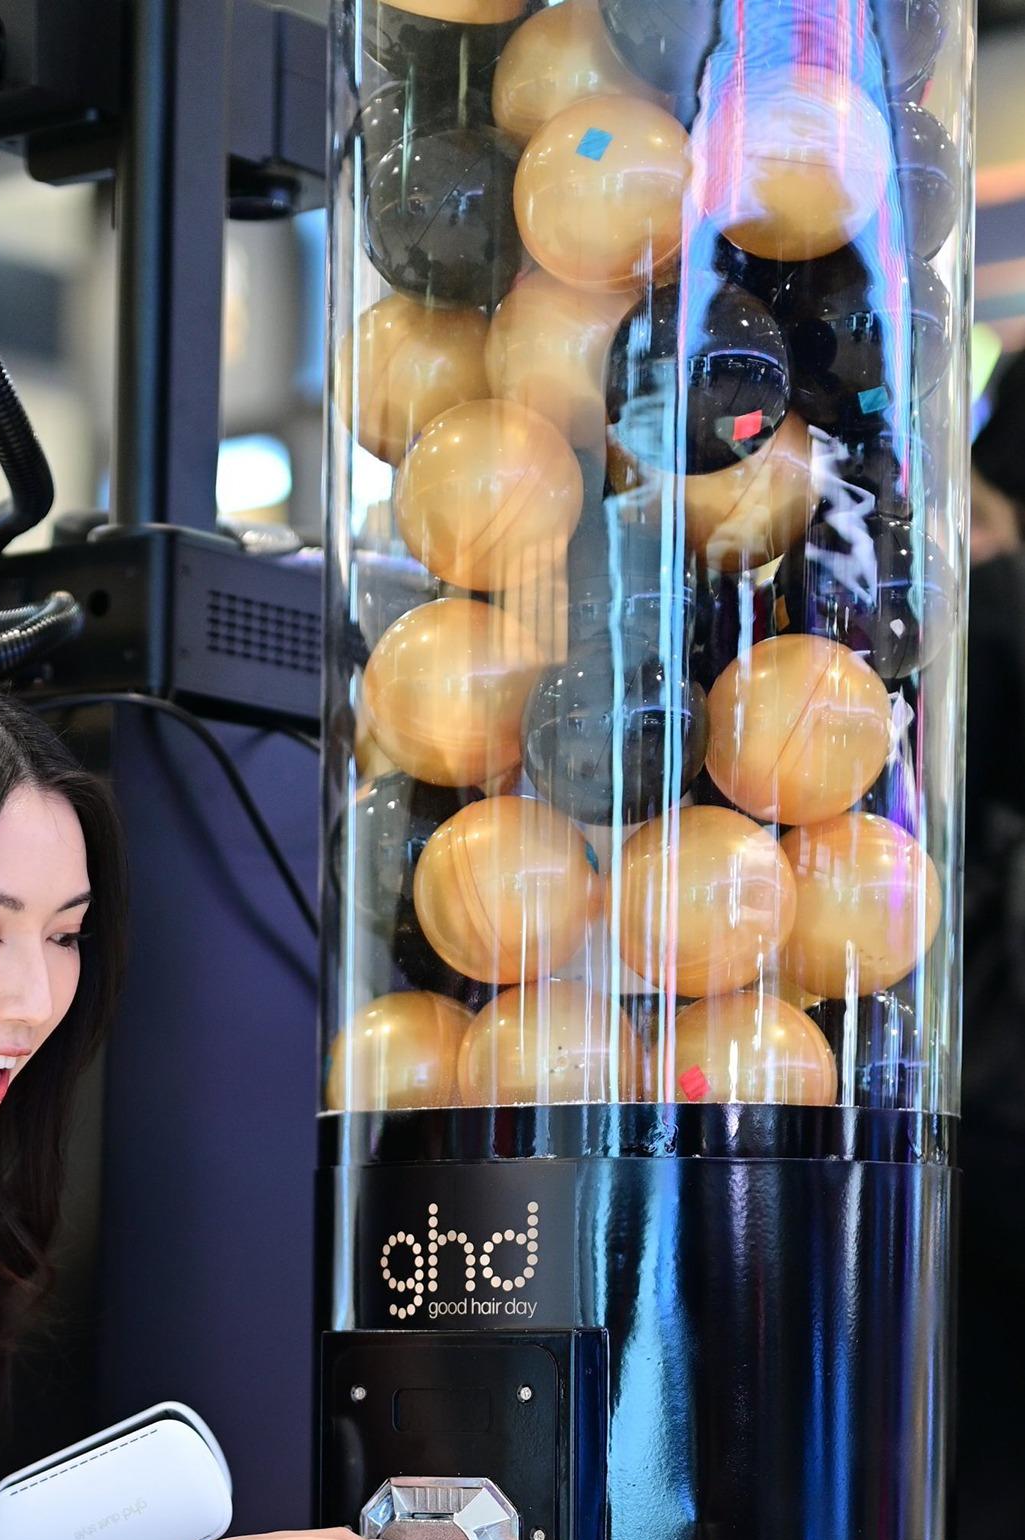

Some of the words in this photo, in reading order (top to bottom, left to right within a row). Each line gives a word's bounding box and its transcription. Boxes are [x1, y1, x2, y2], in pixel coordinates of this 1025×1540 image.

[380, 1201, 539, 1319] ghd
[428, 1298, 467, 1319] good
[471, 1298, 502, 1315] hair
[505, 1298, 538, 1318] day
